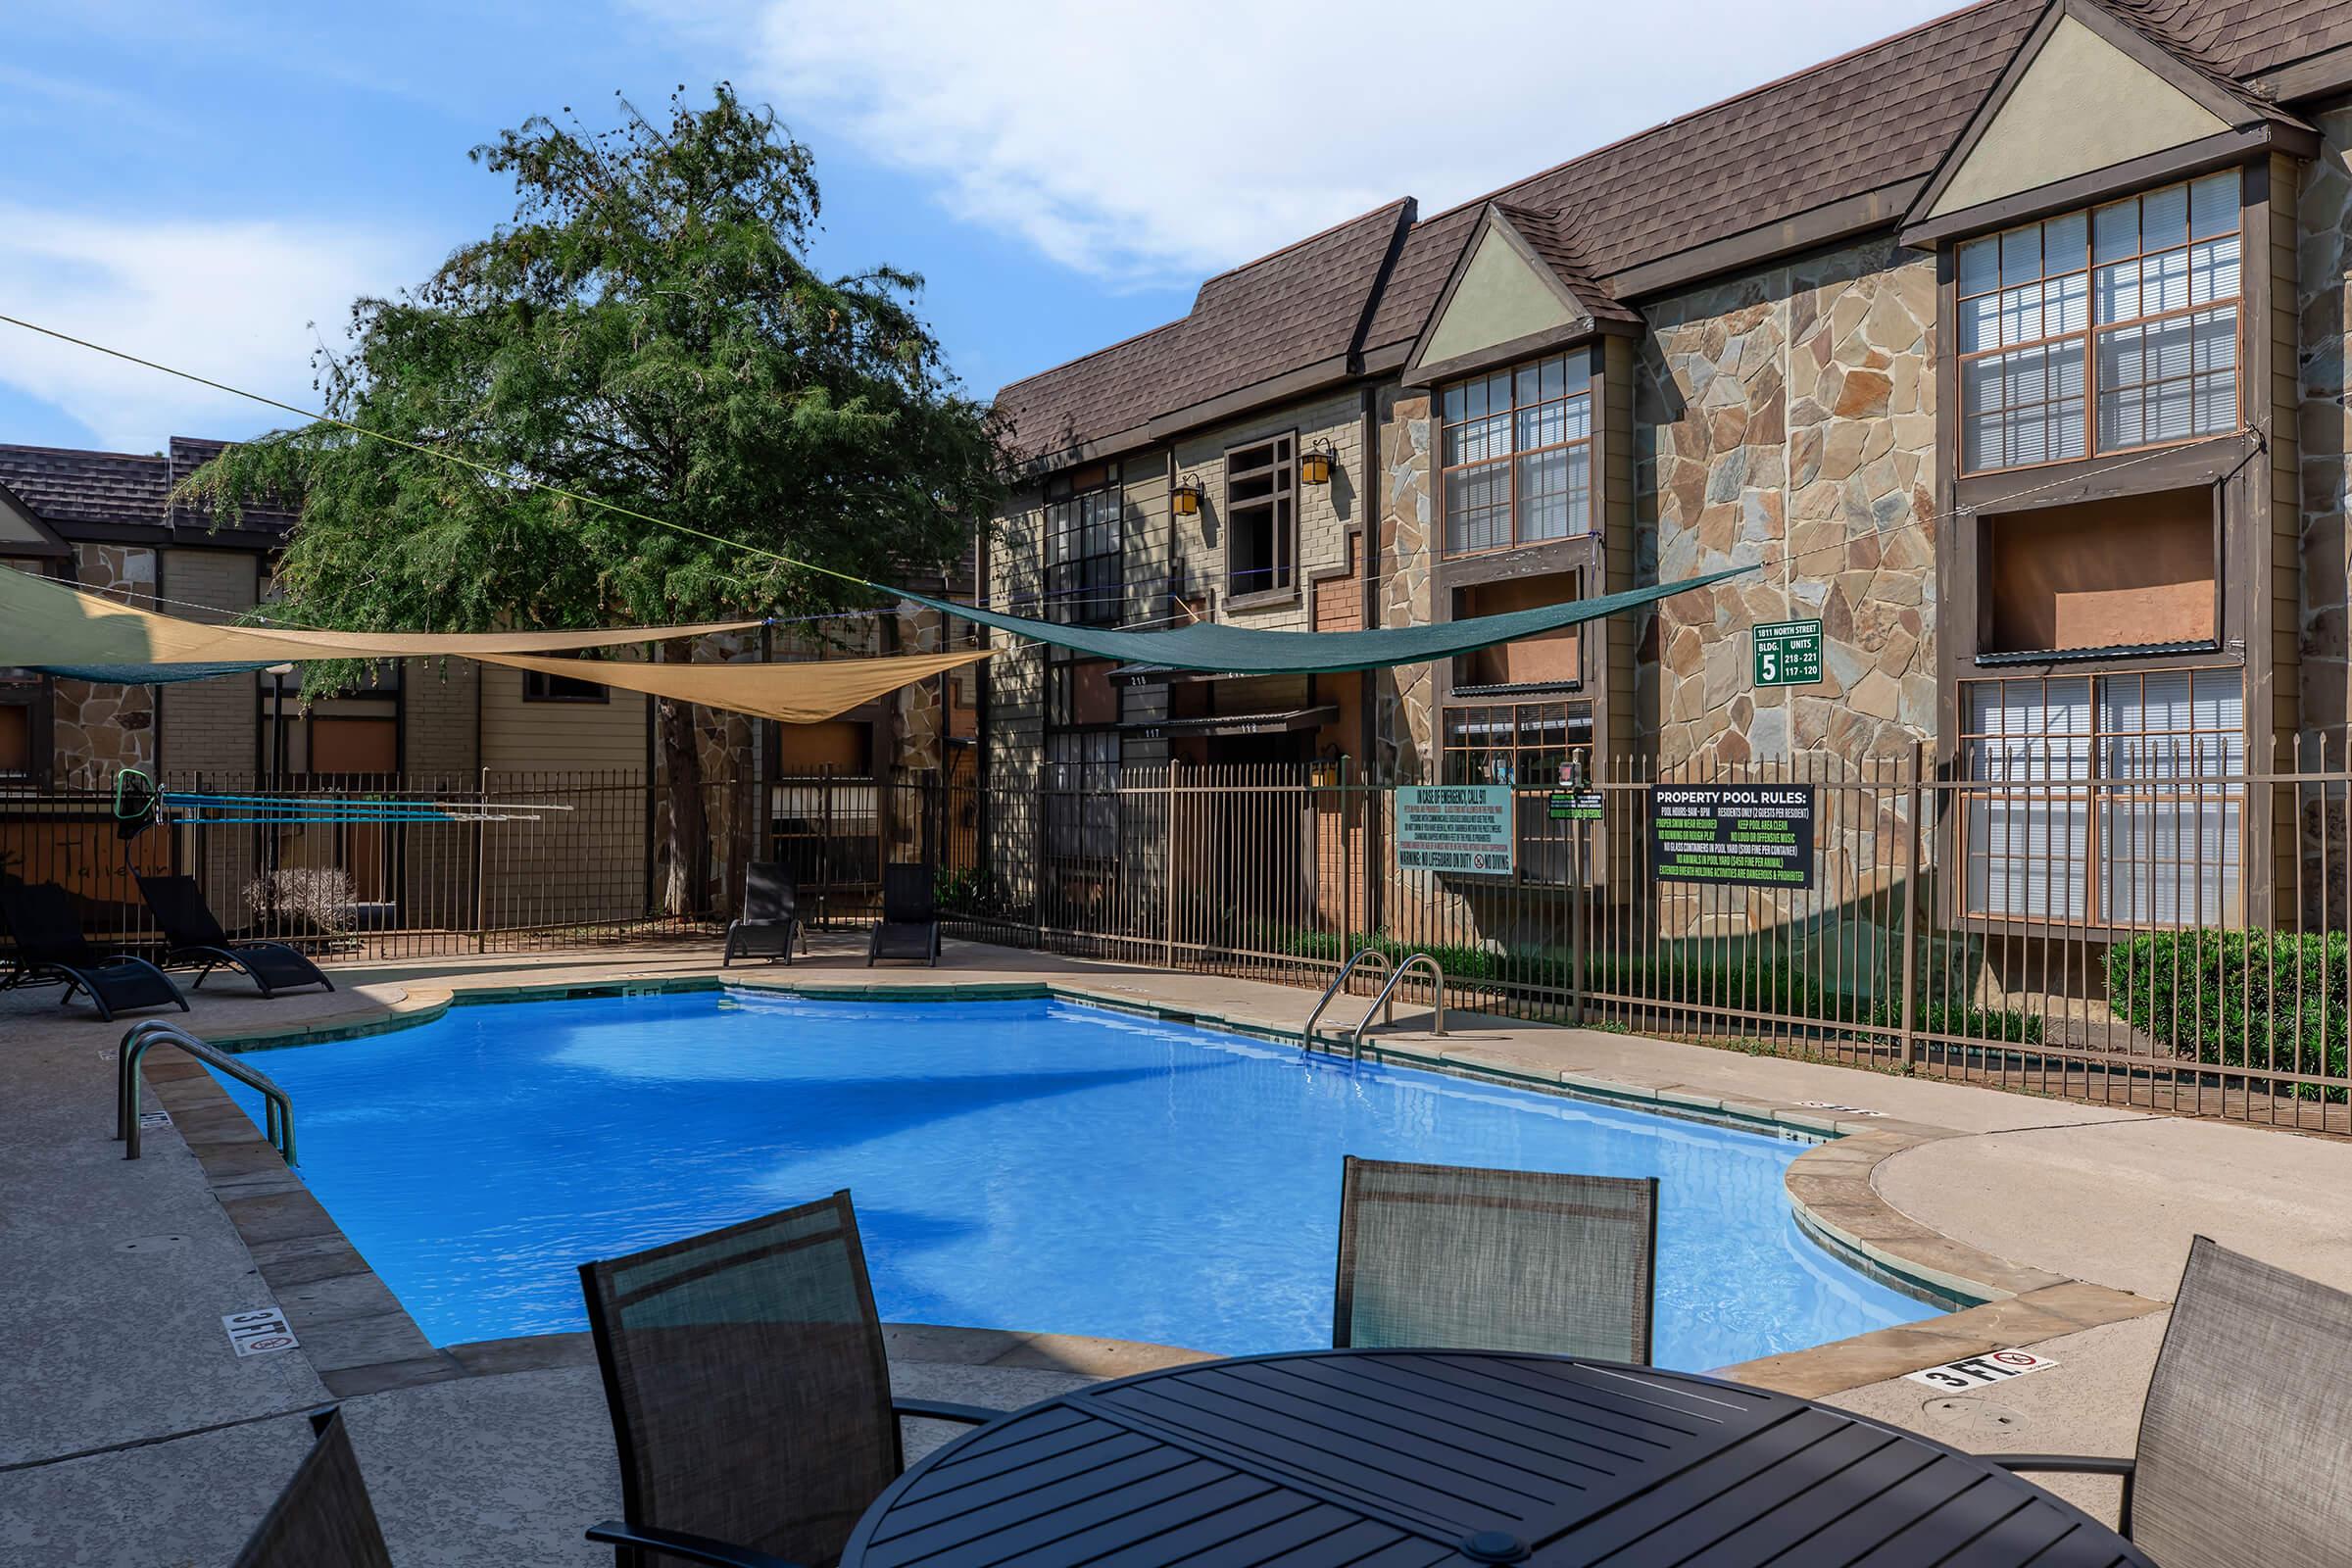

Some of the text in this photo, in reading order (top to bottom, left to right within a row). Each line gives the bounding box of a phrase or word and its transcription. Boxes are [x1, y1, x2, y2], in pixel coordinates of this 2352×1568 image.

[1758, 624, 1817, 637] 1811 NORTH STREET
[1789, 639, 1812, 650] UNITS
[1785, 654, 1799, 664] 218
[1803, 653, 1817, 662] 221
[1762, 654, 1776, 681] 5
[1786, 666, 1799, 676] 117
[1804, 665, 1817, 675] 120
[1657, 792, 1807, 804] PROPERTY POOL RULES:
[233, 1312, 274, 1323] 3
[1925, 1372, 1969, 1388] 3
